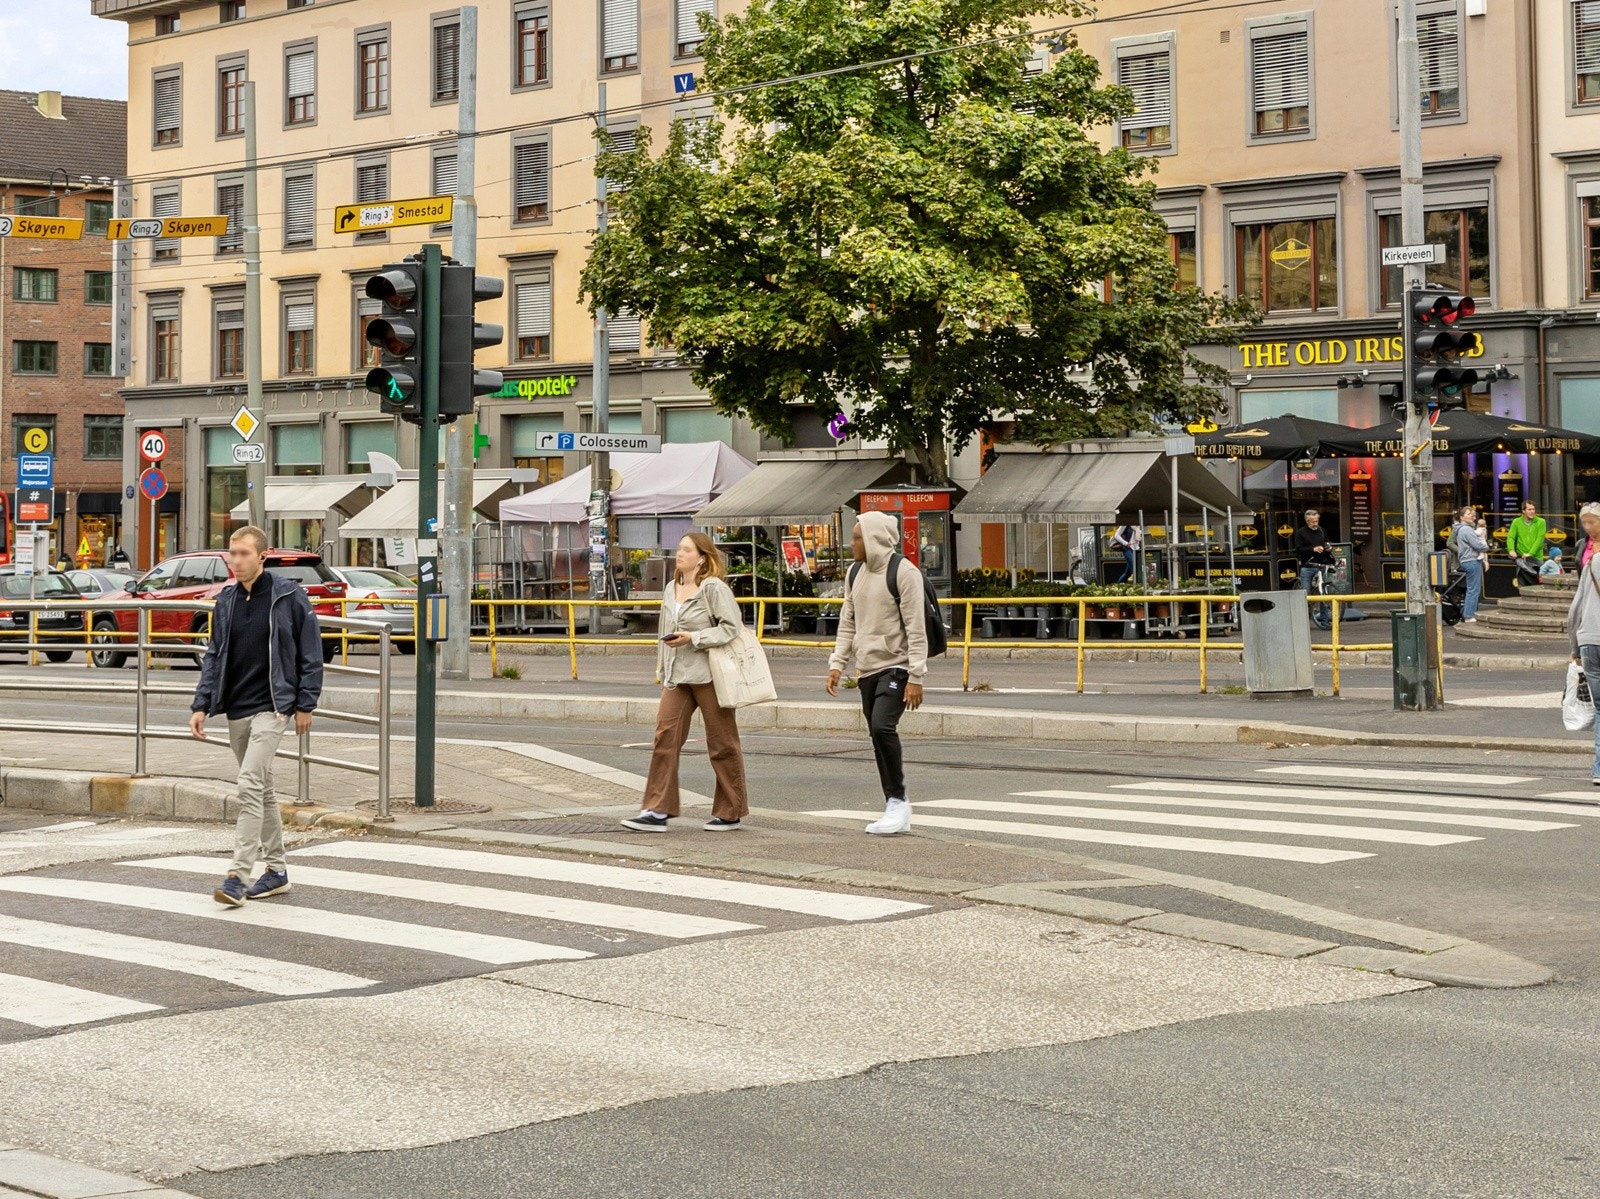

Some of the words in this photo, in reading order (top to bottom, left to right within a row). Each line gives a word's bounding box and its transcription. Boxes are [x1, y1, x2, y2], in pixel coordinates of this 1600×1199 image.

[364, 210, 382, 221] Ring
[383, 210, 389, 219] 3
[397, 203, 444, 219] Smestad
[17, 220, 66, 237] Skøyen
[131, 224, 151, 235] Ring
[151, 223, 159, 234] 2
[167, 221, 212, 236] Skøyen
[1384, 249, 1432, 262] Kirkeveien
[1238, 342, 1290, 368] THE
[1294, 337, 1348, 365] OLD
[1353, 334, 1404, 363] IRIS
[300, 389, 370, 408] OPTIK
[30, 434, 41, 448] C
[145, 439, 163, 453] 40
[562, 438, 570, 448] P
[579, 435, 648, 449] Colosseum
[1365, 441, 1383, 452] THE
[1432, 440, 1448, 451] PUB
[1524, 438, 1539, 450] THE
[1538, 438, 1553, 450] OLD
[236, 448, 254, 461] Ring
[255, 447, 261, 459] 2
[1194, 445, 1208, 456] THE
[1209, 444, 1225, 455] OLD
[1226, 444, 1246, 456] IRISH
[1247, 445, 1262, 456] PUB
[864, 495, 889, 503] TELEFON
[906, 494, 934, 503] TELEFON
